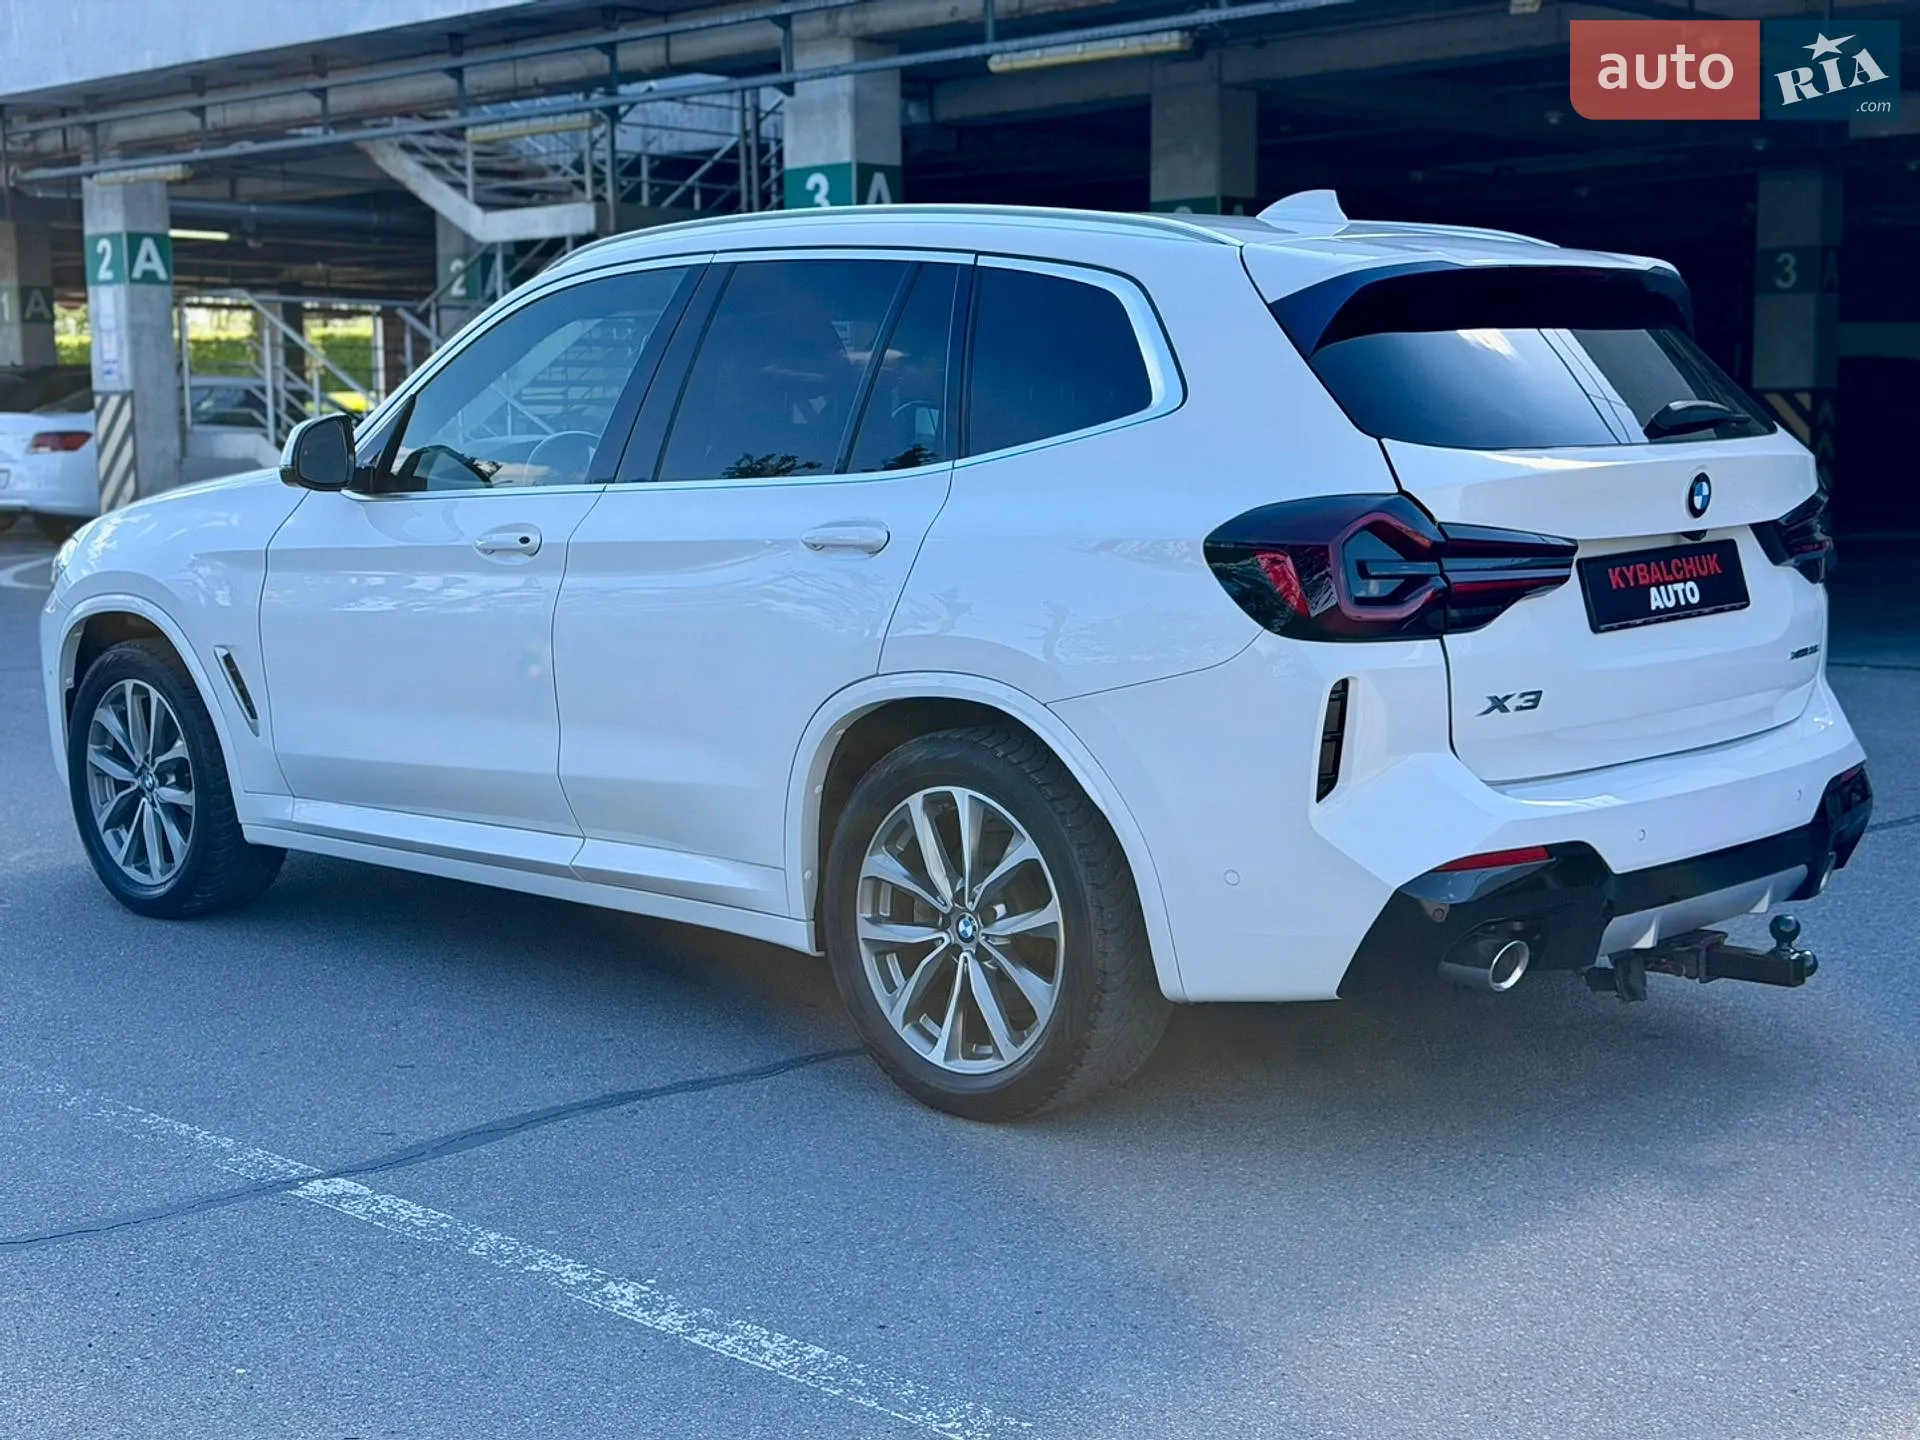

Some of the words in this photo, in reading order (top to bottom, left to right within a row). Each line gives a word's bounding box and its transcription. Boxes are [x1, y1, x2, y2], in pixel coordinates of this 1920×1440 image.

[97, 238, 114, 280] 2
[131, 237, 169, 280] A
[1775, 252, 1797, 288] 3
[1608, 553, 1721, 589] KYBALCHUK
[1650, 581, 1700, 610] AUTO
[1475, 690, 1543, 717] X3
